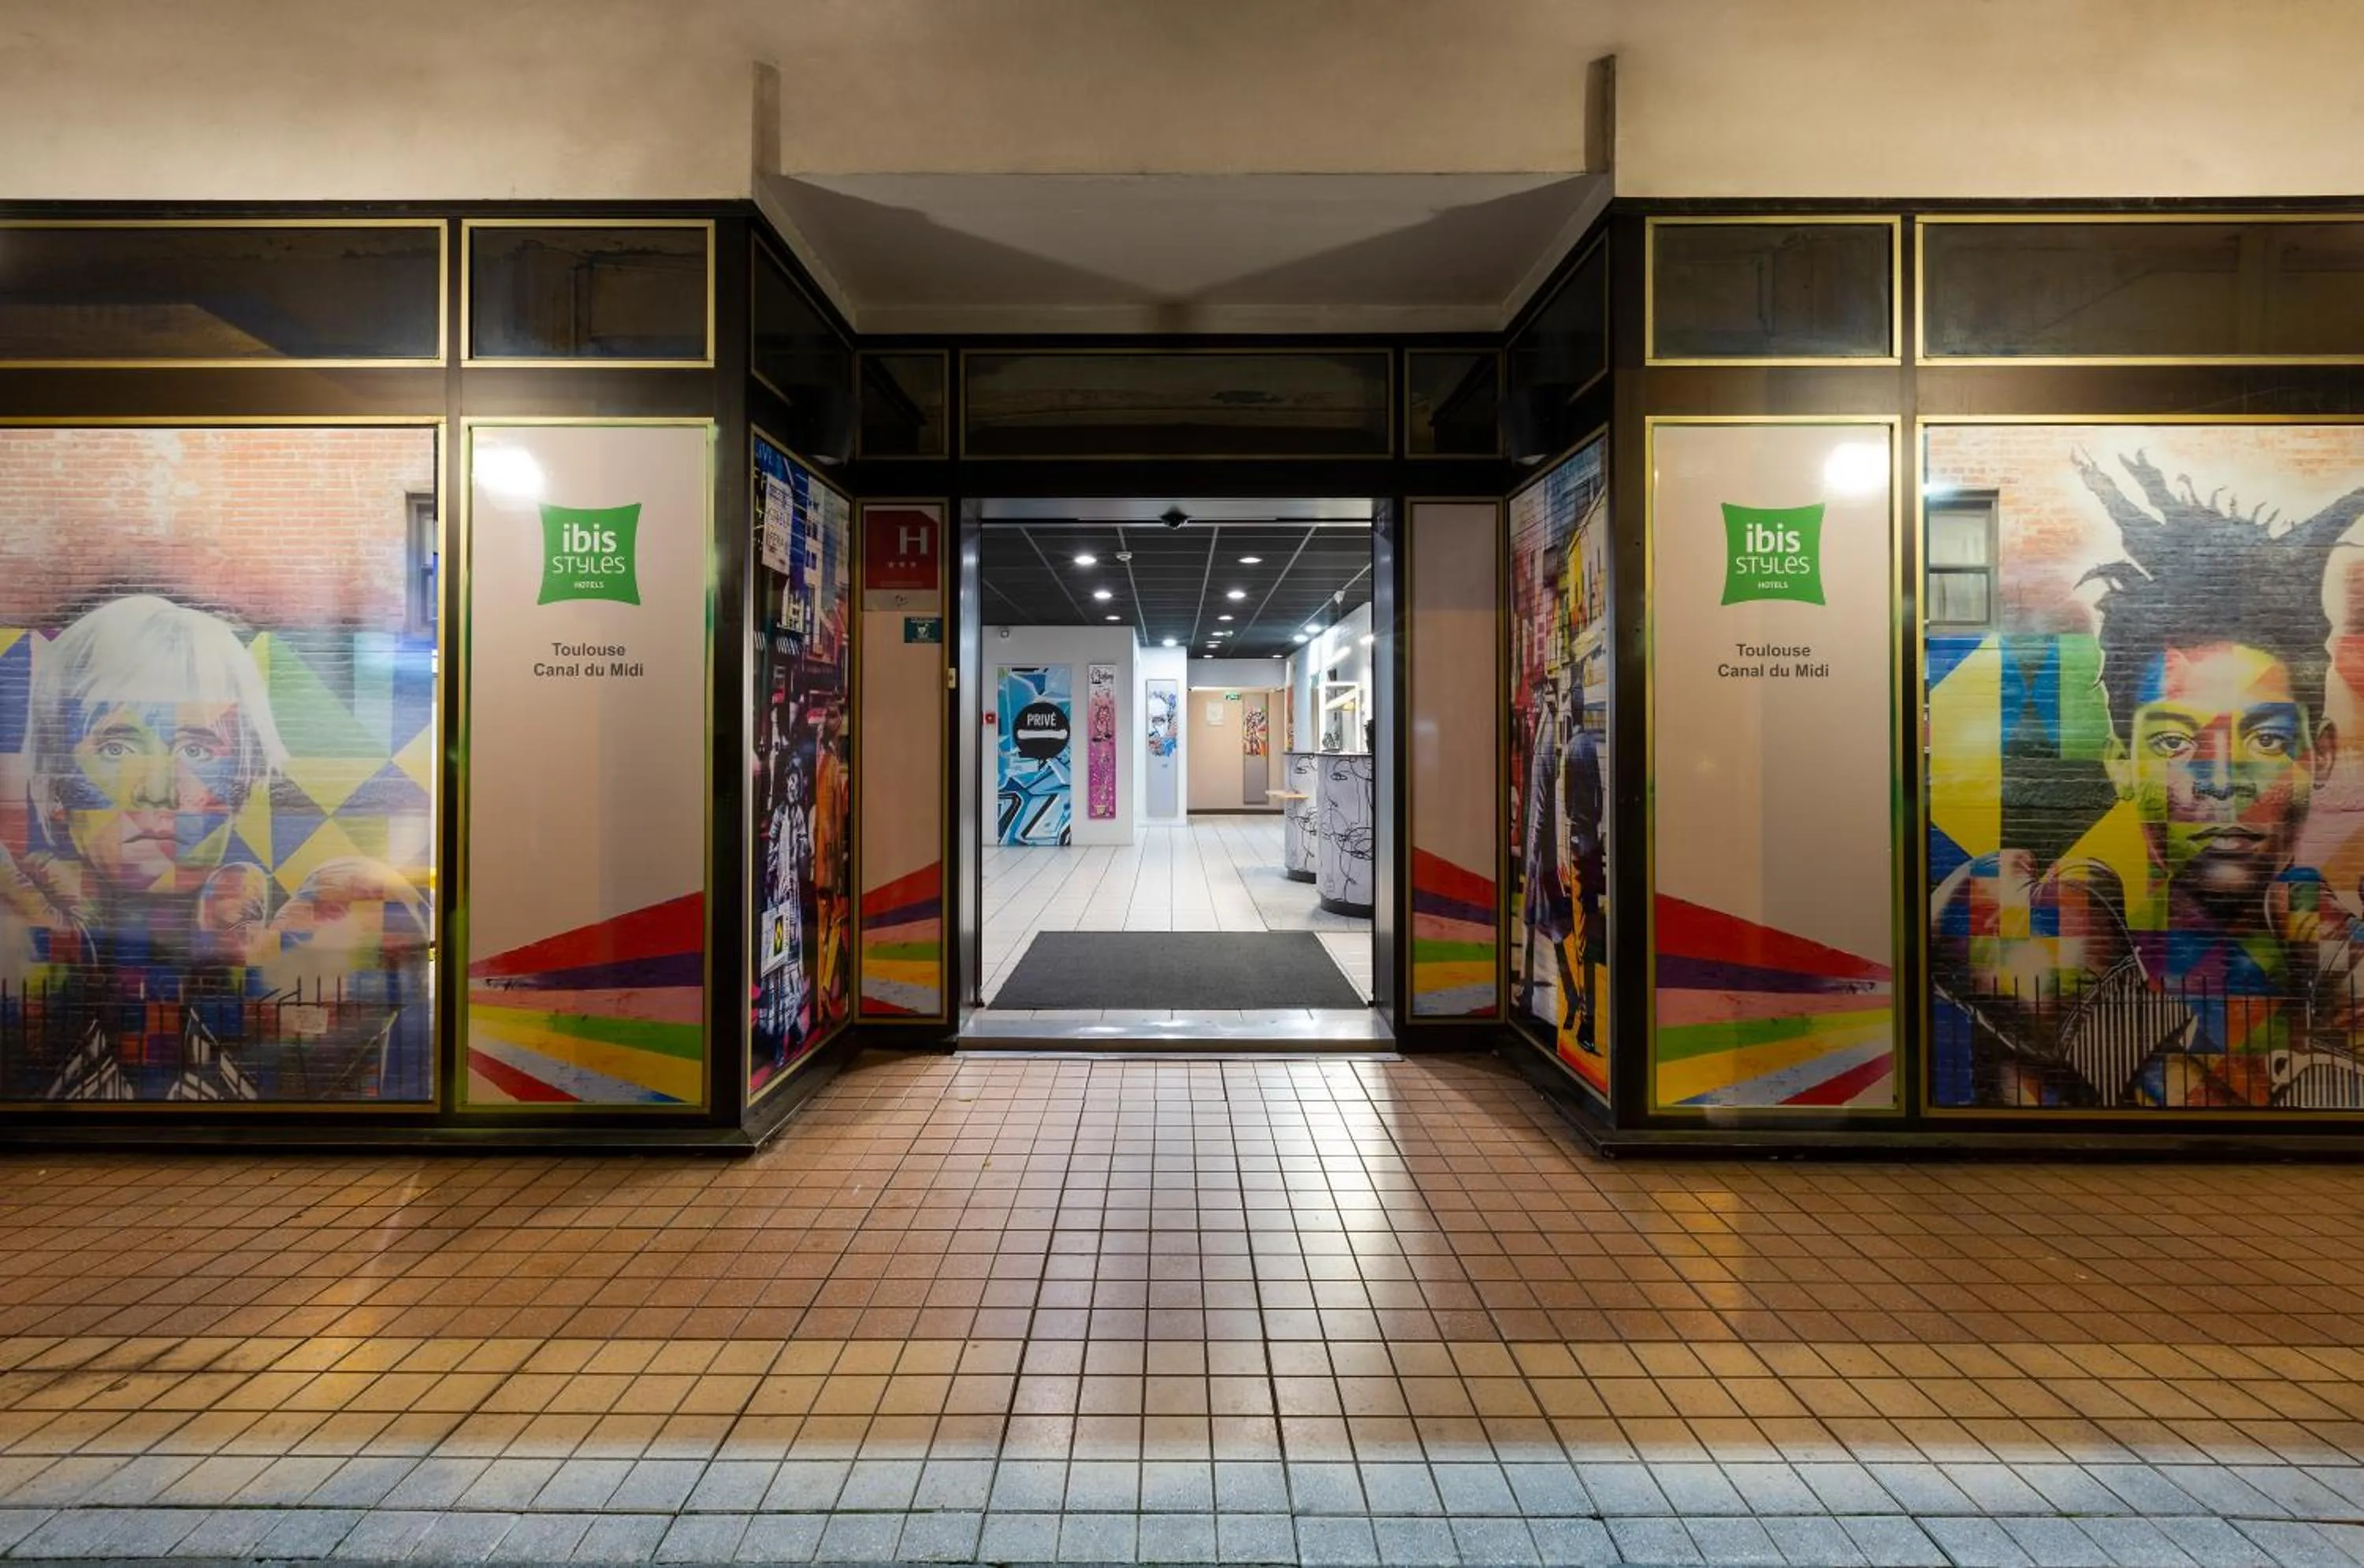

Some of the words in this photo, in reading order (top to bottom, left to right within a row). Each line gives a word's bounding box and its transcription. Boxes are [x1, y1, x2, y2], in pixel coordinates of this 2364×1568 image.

[563, 523, 617, 552] ibis
[899, 526, 928, 555] H
[1746, 523, 1801, 552] ibis
[574, 581, 604, 589] HOTELS
[1758, 581, 1789, 589] HOTELS
[552, 642, 626, 656] Toulouse
[1736, 643, 1811, 657] Toulouse
[533, 663, 579, 677] Canal
[585, 663, 604, 677] du
[611, 663, 644, 677] Midi
[1717, 663, 1764, 678] Canal
[1769, 663, 1790, 678] du
[1795, 663, 1829, 678] Midi
[1027, 712, 1057, 726] PRIVÉ
